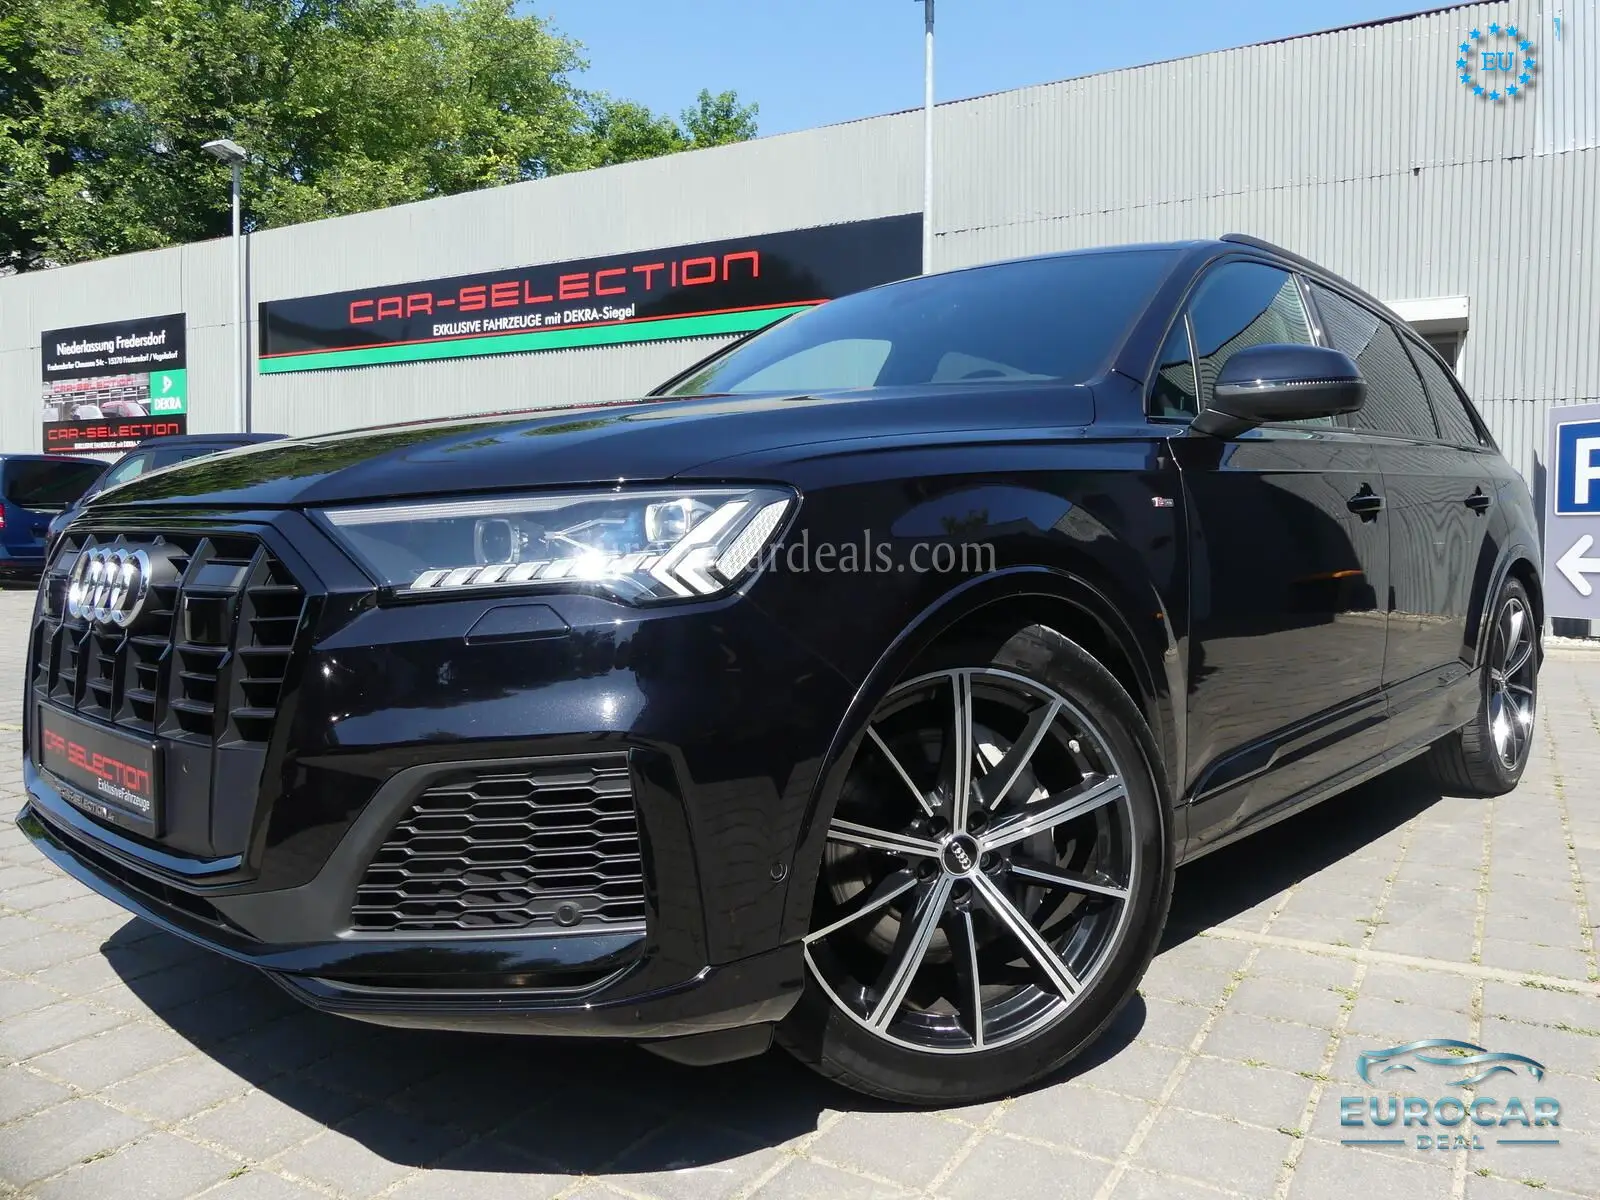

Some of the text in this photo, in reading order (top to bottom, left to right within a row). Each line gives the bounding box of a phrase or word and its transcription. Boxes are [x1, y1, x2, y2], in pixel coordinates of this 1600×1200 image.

[349, 250, 759, 324] CAR-SELECTION
[433, 303, 636, 336] EXKLUSIVE FAHRZEUGE mit DEKRA-Siegel
[56, 330, 166, 356] Niederlassung Fredersdorf
[154, 397, 182, 410] DEKRA
[48, 423, 179, 440] CAR-SELECTION
